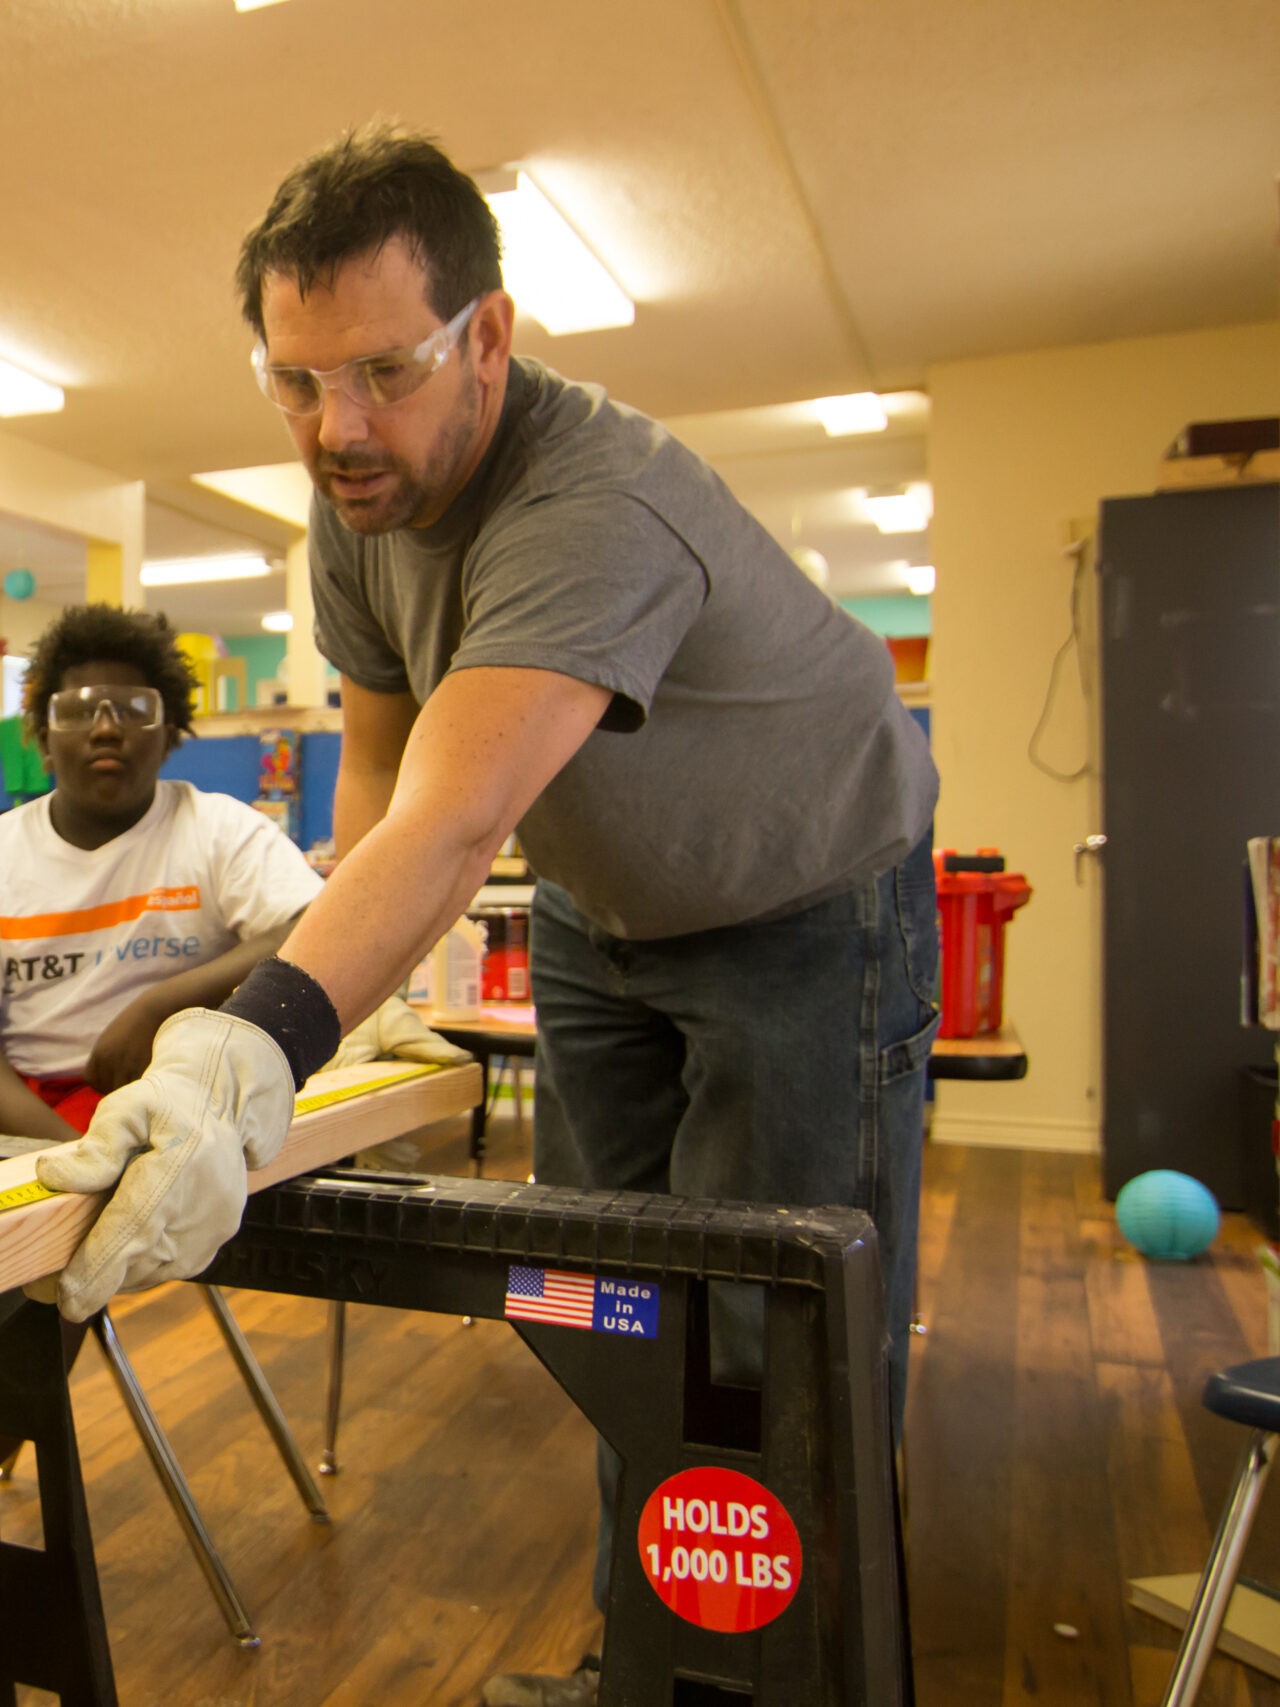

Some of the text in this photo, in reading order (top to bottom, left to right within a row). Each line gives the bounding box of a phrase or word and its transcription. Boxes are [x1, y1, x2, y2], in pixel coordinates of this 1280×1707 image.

[600, 1281, 651, 1299] Made
[615, 1300, 633, 1315] in
[603, 1316, 645, 1334] USA
[663, 1497, 769, 1540] HOLDS
[646, 1544, 793, 1590] 1,000 LBS
